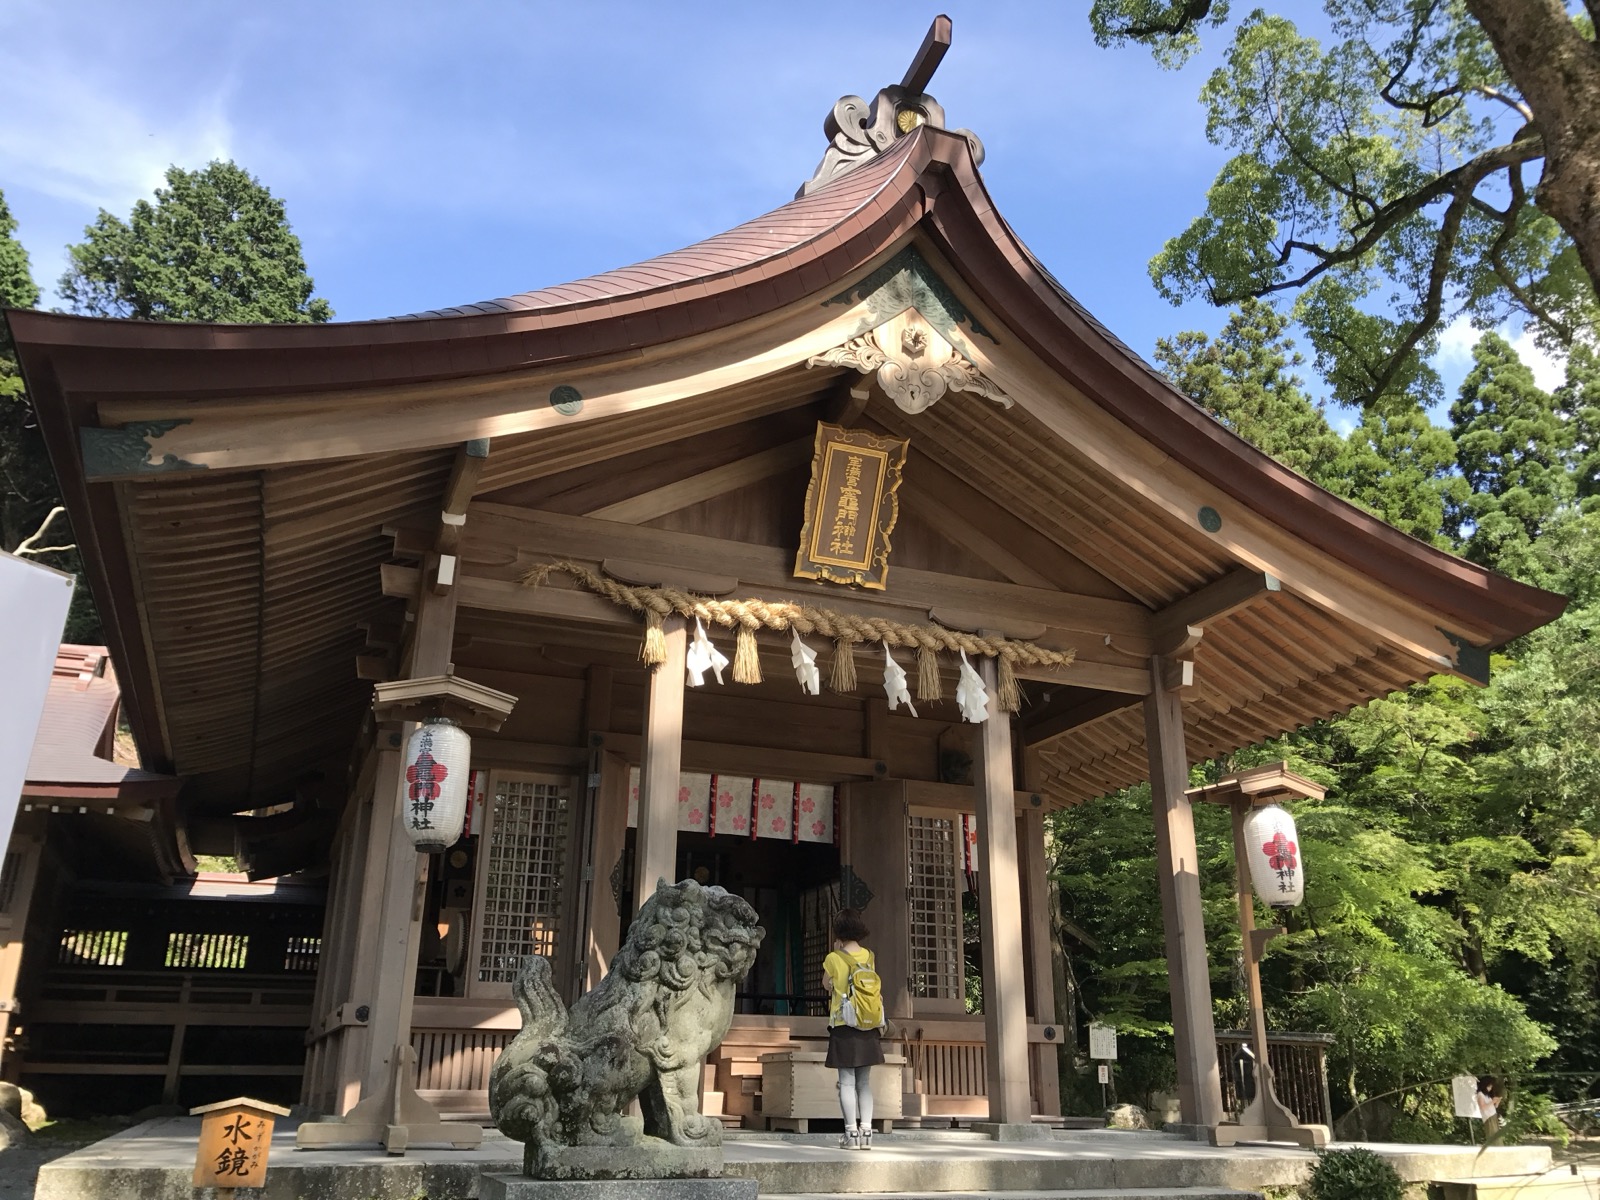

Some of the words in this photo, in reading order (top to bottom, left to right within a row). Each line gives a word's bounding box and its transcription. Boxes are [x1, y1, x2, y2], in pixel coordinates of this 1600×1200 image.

[214, 1114, 252, 1177] 水鏡
[250, 1120, 265, 1169] みずかがみ
